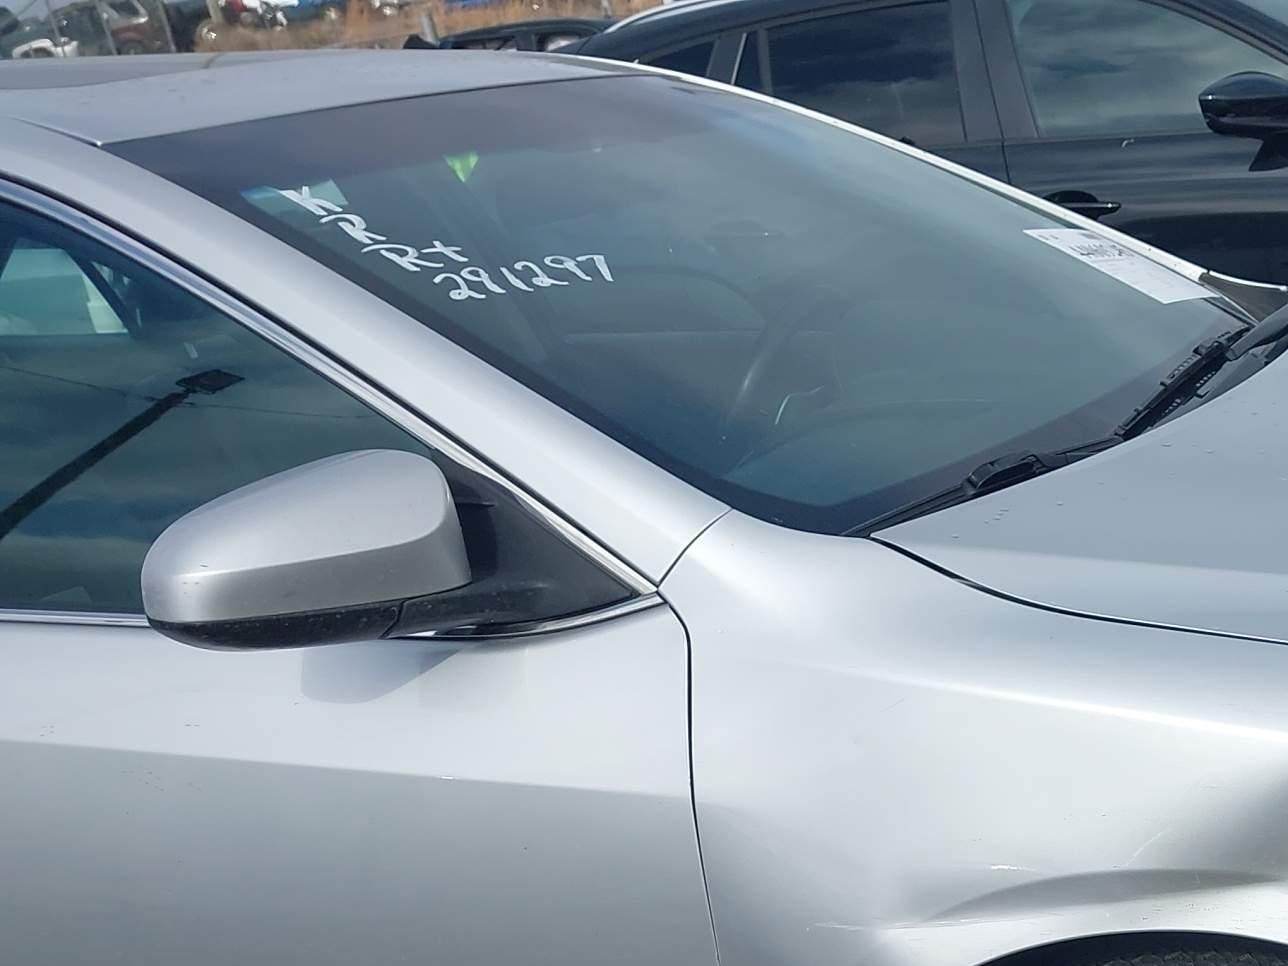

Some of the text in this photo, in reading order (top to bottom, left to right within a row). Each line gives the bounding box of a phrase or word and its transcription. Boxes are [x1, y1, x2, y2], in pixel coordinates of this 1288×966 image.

[279, 186, 343, 215] K
[319, 213, 387, 244] R
[433, 254, 614, 301] 291297
